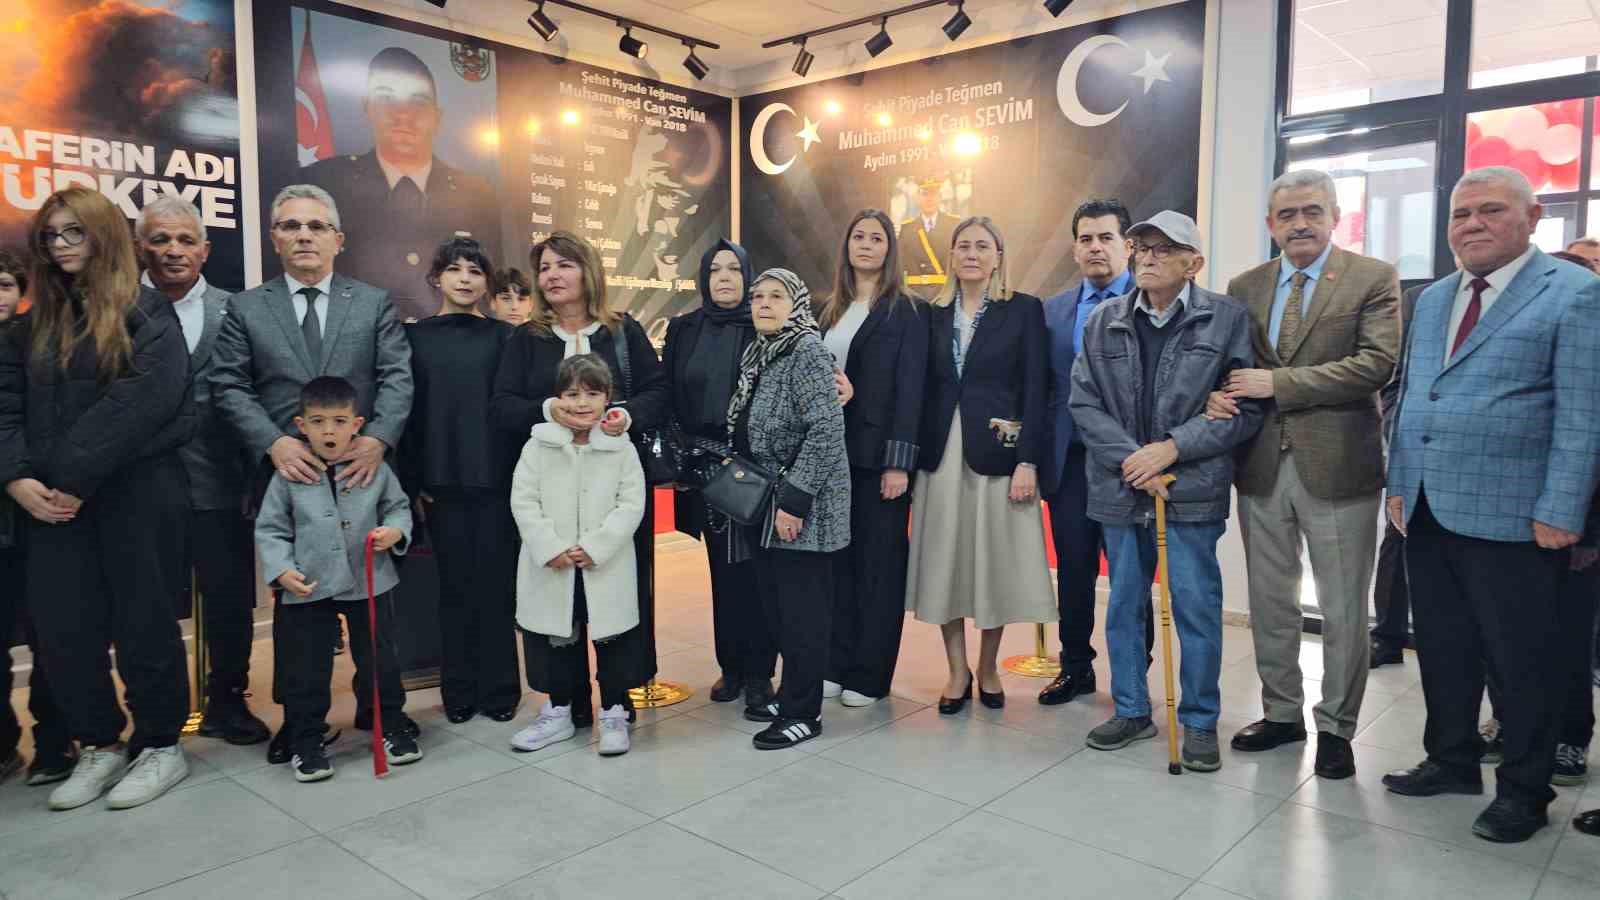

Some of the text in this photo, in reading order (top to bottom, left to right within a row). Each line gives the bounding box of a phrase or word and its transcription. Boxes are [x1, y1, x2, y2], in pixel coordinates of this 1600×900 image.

[559, 81, 706, 124] Muhammed Can SEVİM
[612, 77, 647, 96] Piyade
[899, 90, 943, 114] Piyade
[945, 80, 1002, 104] Teğmen
[663, 119, 688, 133] 2018
[938, 112, 970, 135] Can
[975, 96, 1033, 129] SEVİM
[163, 149, 235, 185] ADI
[863, 151, 897, 172] Aydın
